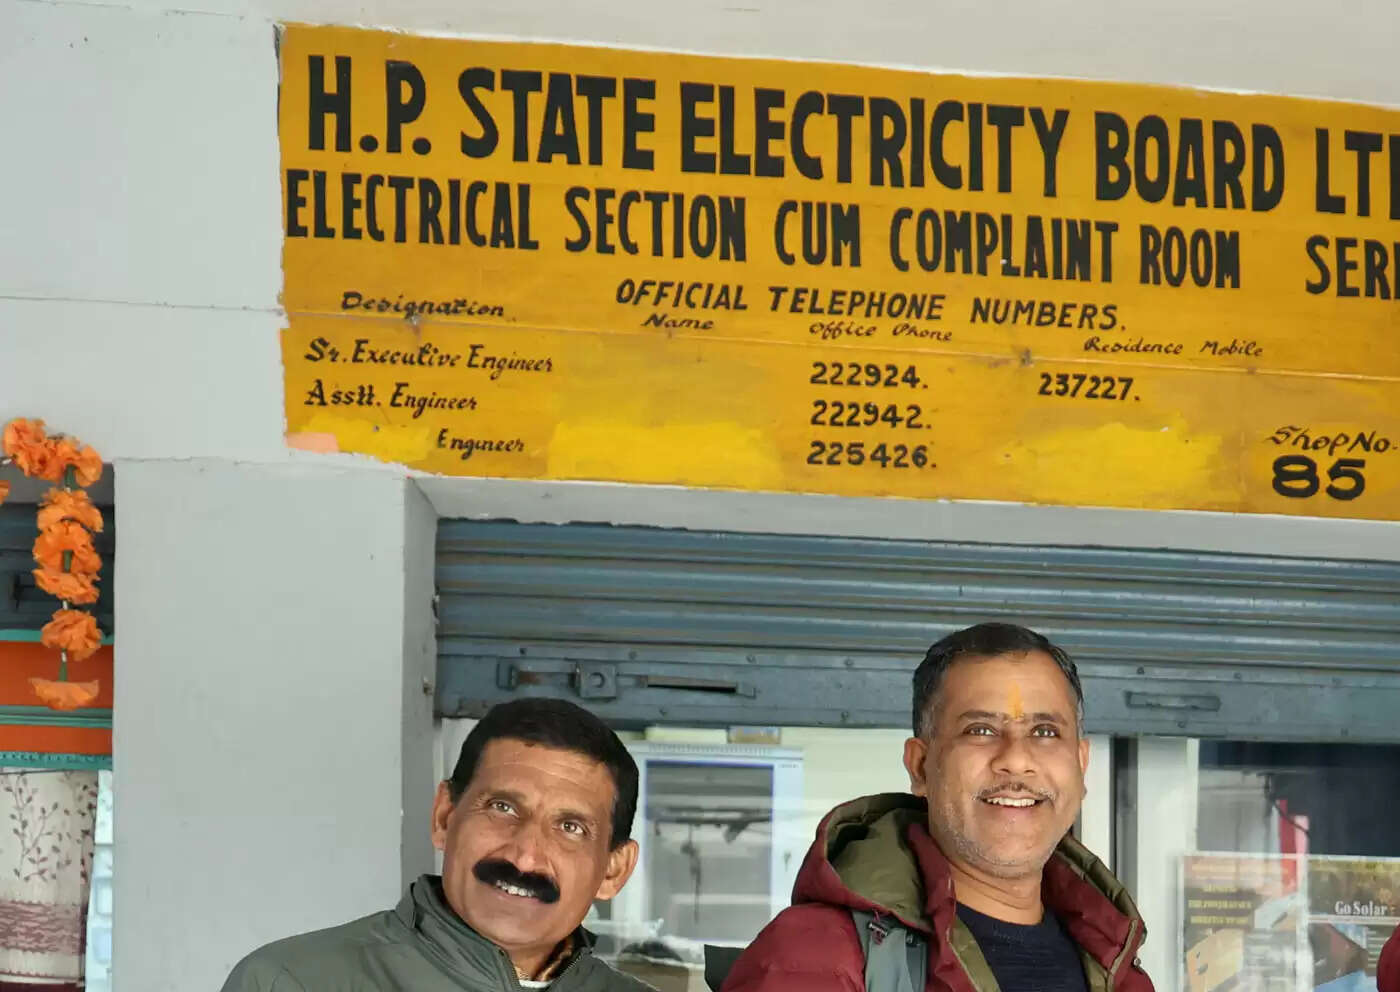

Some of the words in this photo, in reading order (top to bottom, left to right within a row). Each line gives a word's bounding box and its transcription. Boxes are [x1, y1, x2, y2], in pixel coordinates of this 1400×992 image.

[308, 55, 432, 156] H.P.
[458, 67, 657, 171] STATE
[679, 82, 1070, 198] ELECTRICITY
[1094, 111, 1285, 213] BOARD
[286, 169, 539, 251] ELECTRICAL
[565, 186, 747, 262] SECTION
[774, 200, 861, 268] CUM
[890, 207, 1119, 283] COMPLAINT
[1139, 224, 1240, 289] ROOM
[341, 291, 505, 320] Designation
[641, 313, 714, 331] Name
[809, 320, 877, 340] Office
[892, 323, 953, 342] Phone
[1083, 337, 1183, 355] Residence
[1199, 340, 1264, 357] Mobile
[616, 279, 748, 310] OFFICIAL
[769, 287, 945, 321] TELEPHONE
[970, 298, 1127, 331] NUMBERS.
[466, 343, 553, 381] Engineer
[390, 382, 478, 420] Engineer
[437, 428, 525, 461] Engineer
[1272, 455, 1367, 501] 85
[1334, 900, 1352, 917] Go
[1353, 900, 1388, 917] Solar
